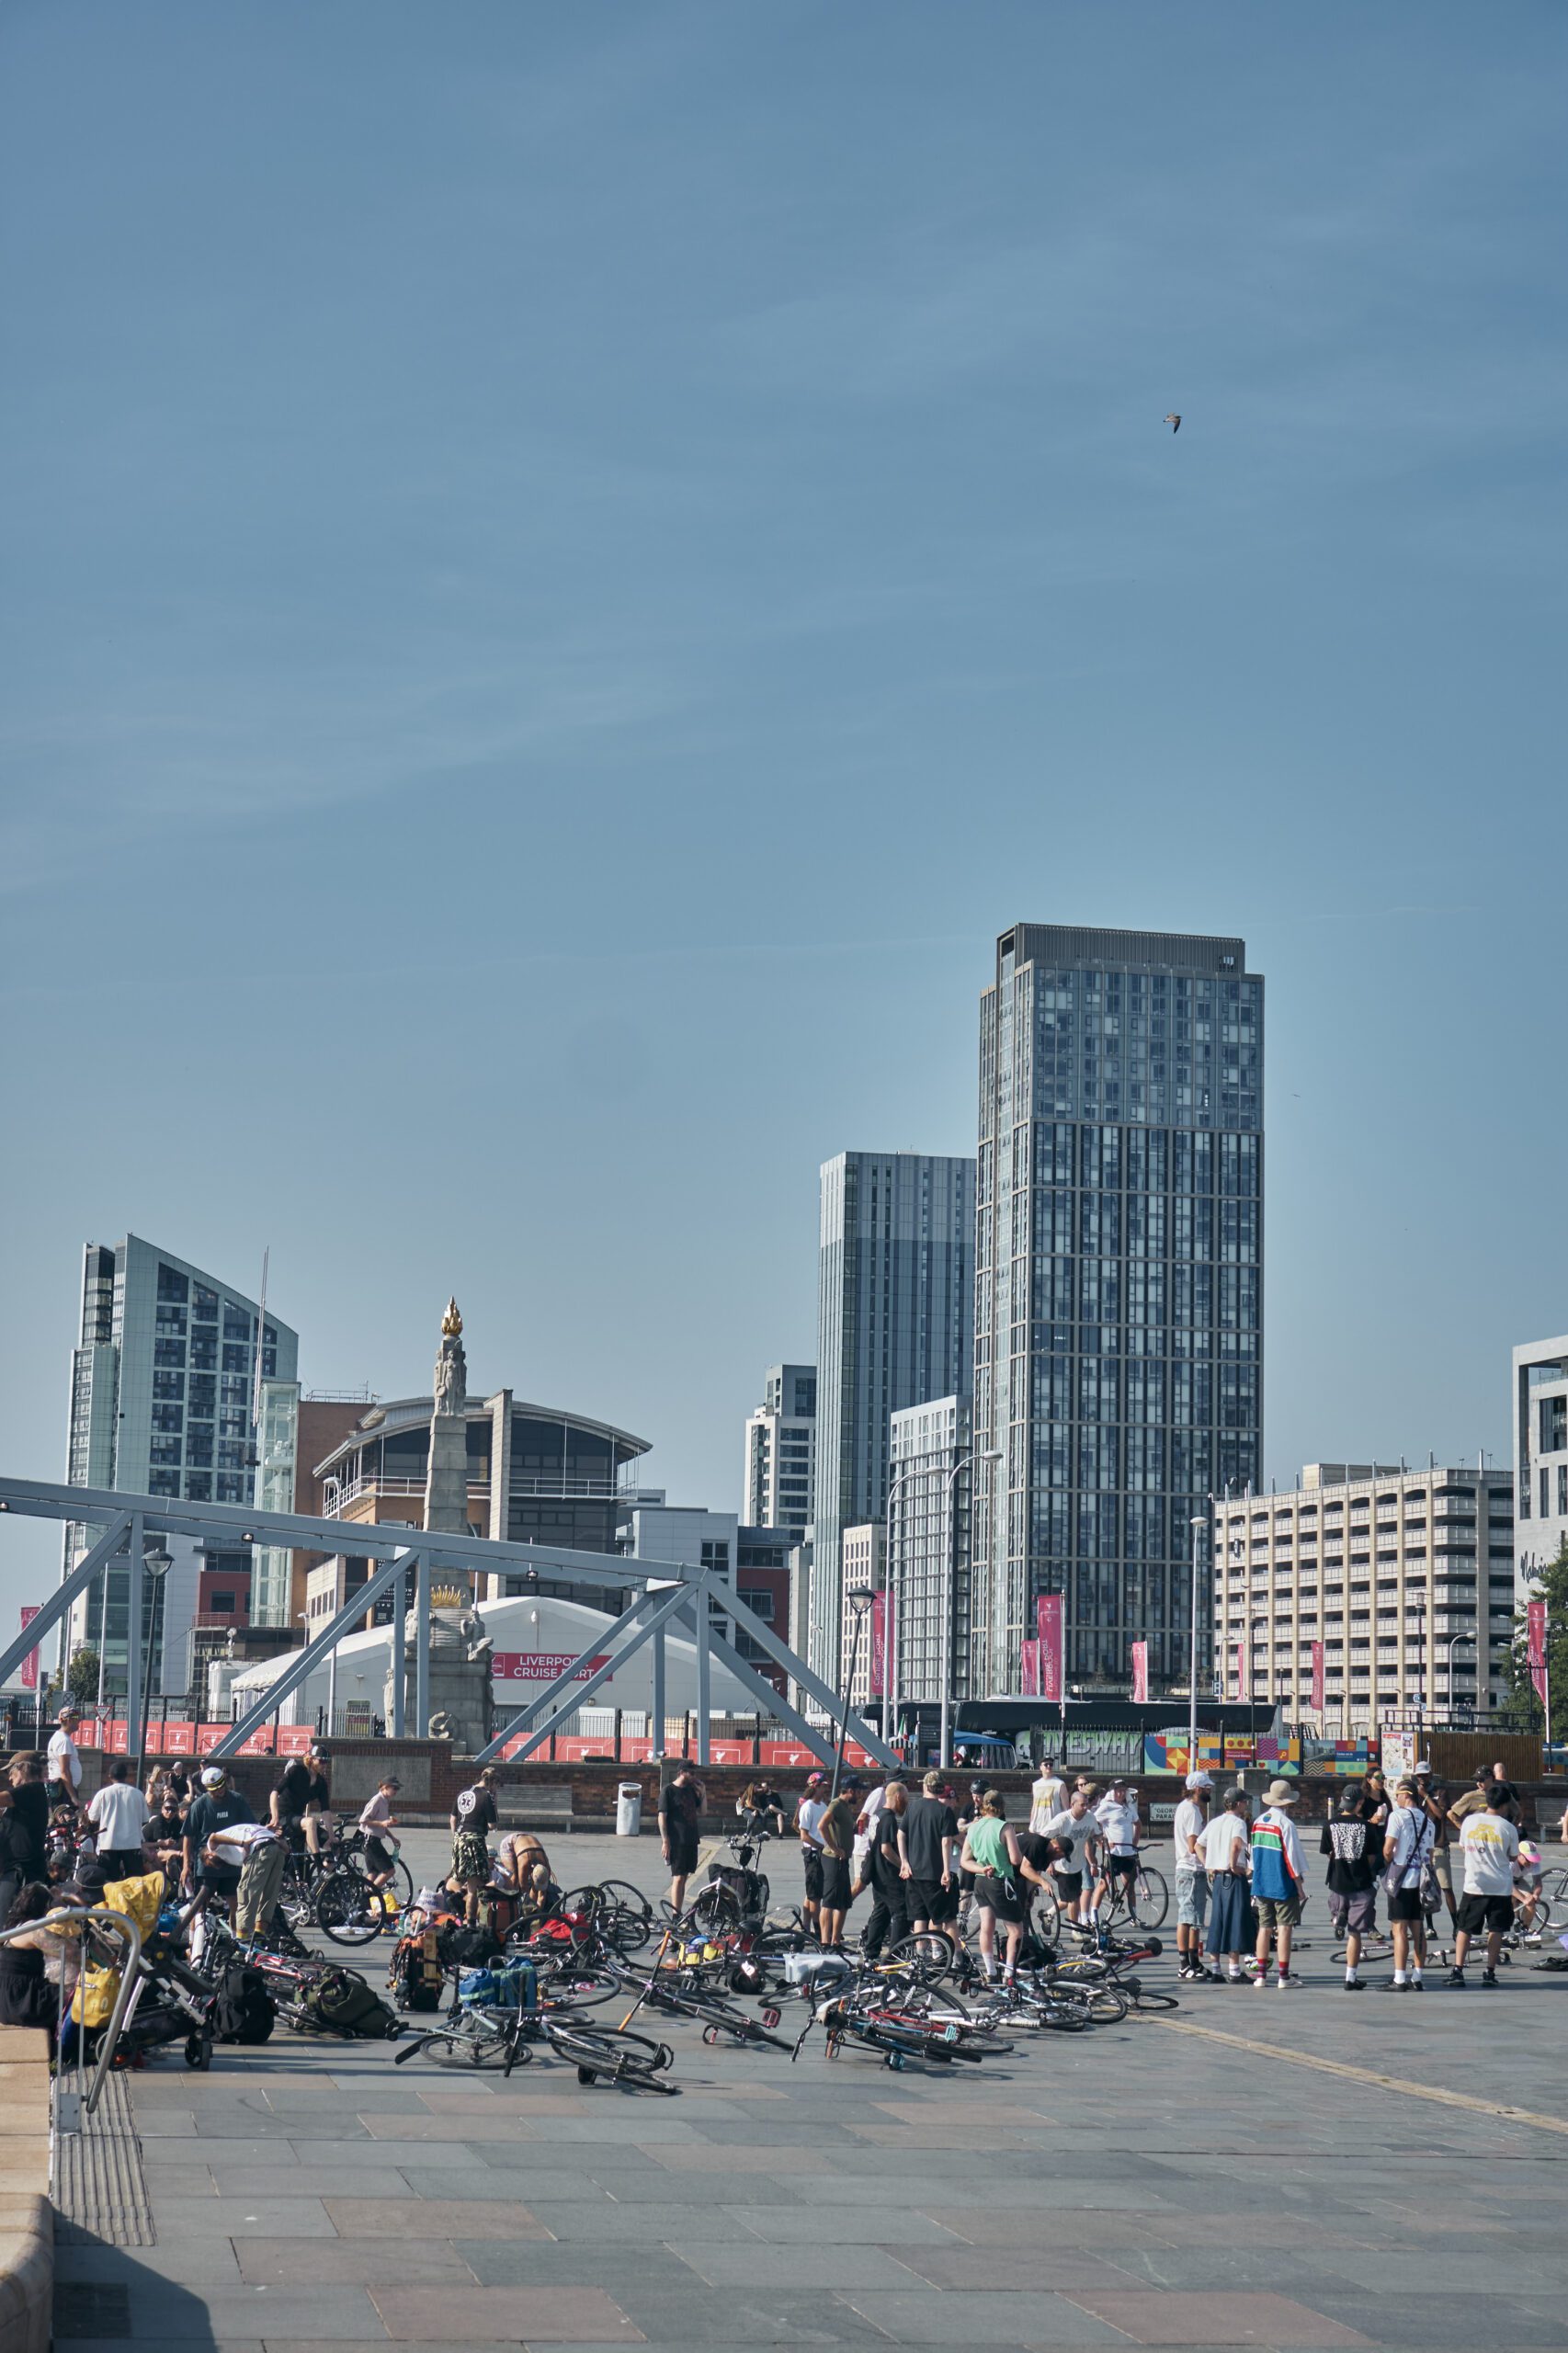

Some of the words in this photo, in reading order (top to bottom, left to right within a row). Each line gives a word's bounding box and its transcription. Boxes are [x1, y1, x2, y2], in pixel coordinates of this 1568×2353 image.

[520, 1656, 588, 1667] LIVERPO
[514, 1667, 558, 1677] CRUISE
[1042, 1731, 1142, 1756] AVESWAY
